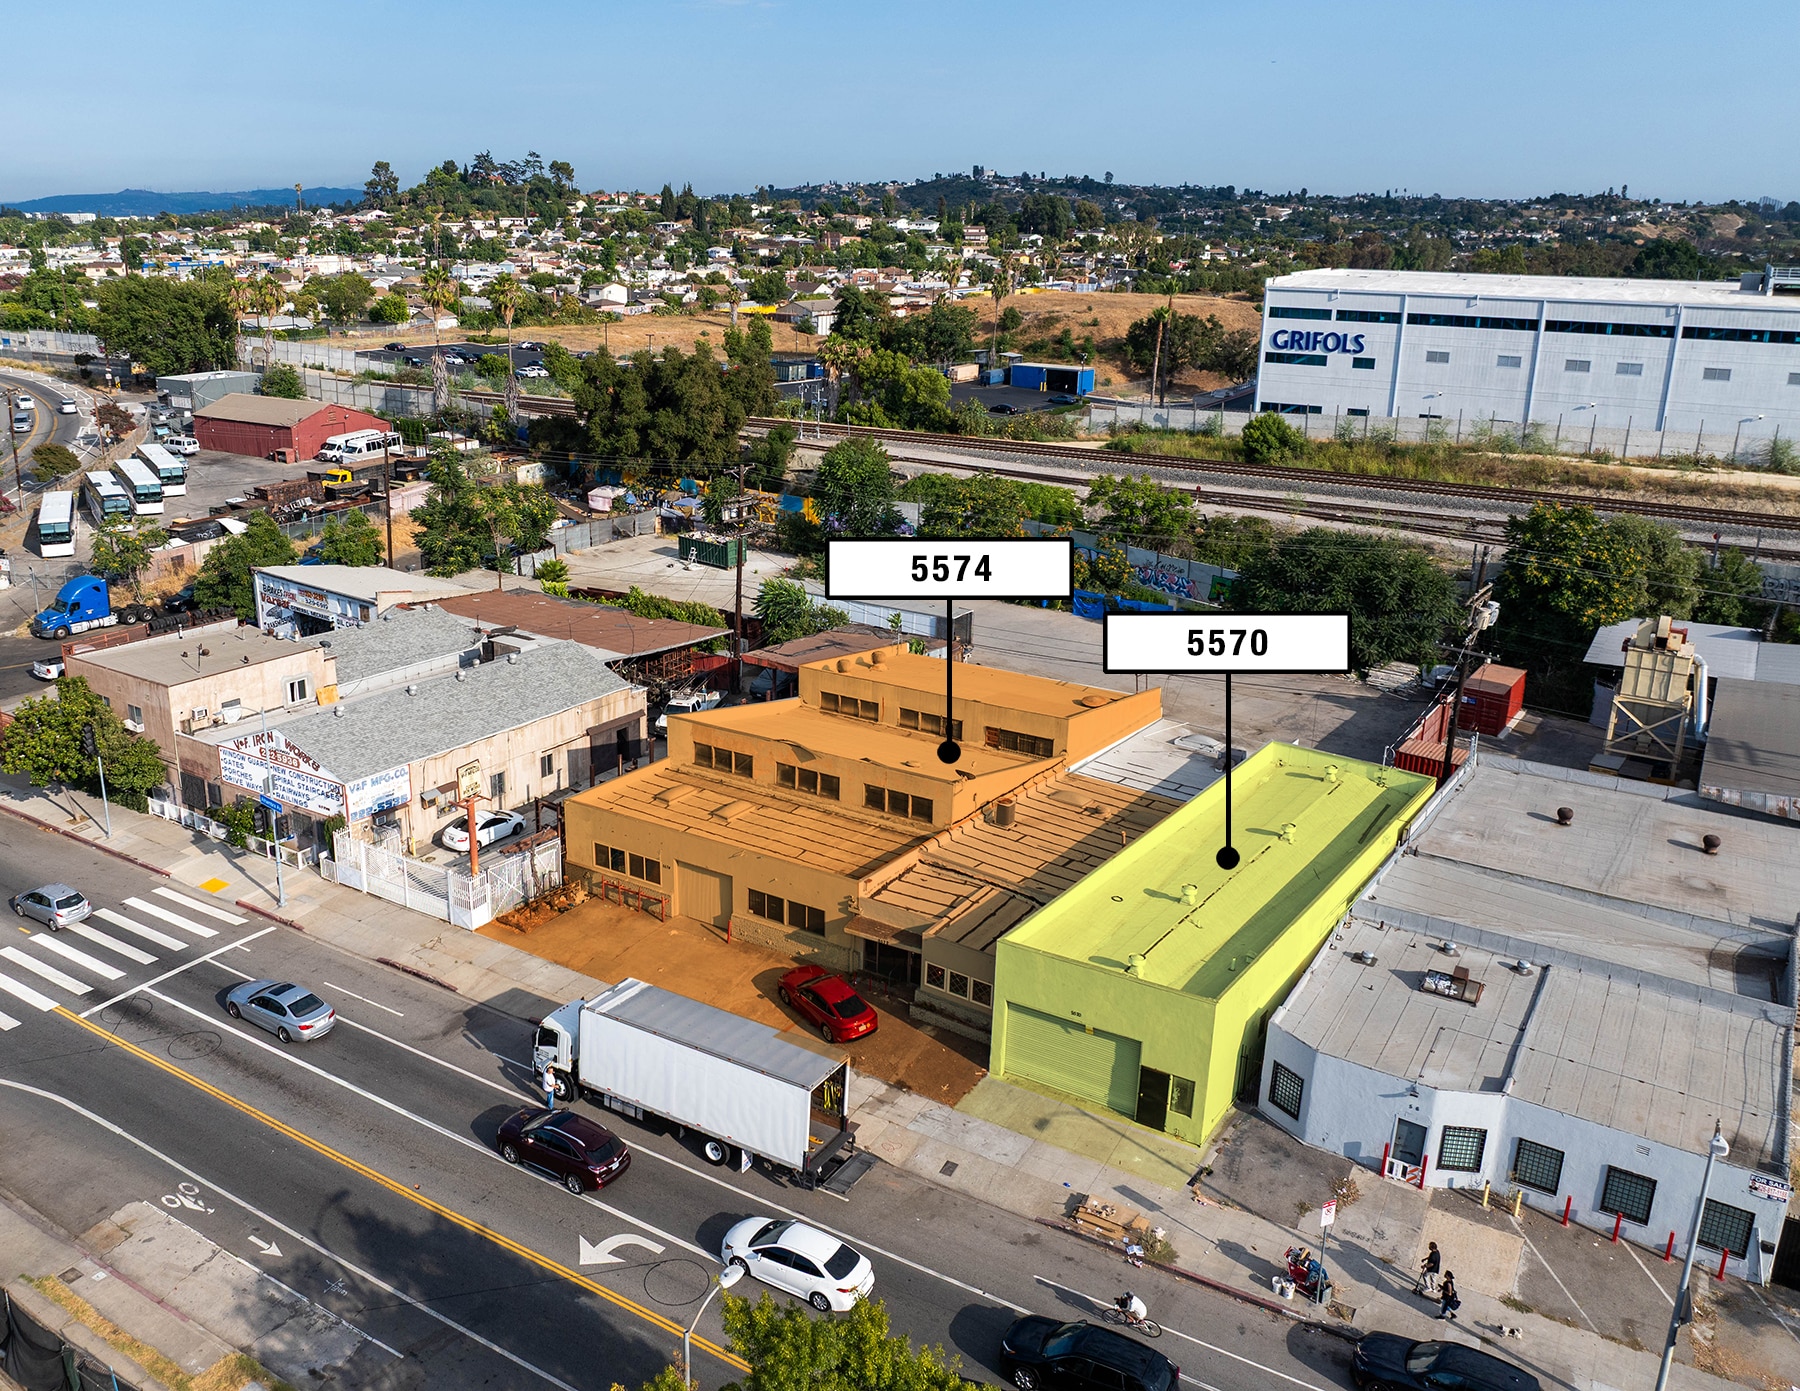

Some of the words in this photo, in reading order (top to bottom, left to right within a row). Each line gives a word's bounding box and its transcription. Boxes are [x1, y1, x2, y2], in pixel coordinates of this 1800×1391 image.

[1271, 329, 1365, 354] GRIFOLS
[222, 750, 246, 762] WINDOW
[284, 738, 321, 772] WORKS
[223, 758, 244, 770] GATES
[224, 766, 253, 781] PORCHES
[272, 765, 286, 775] NEW
[288, 770, 341, 793] CONSTRUCTION
[273, 774, 294, 786] SPIRAL
[224, 774, 244, 786] DRIVE
[246, 780, 264, 792] WAYS
[348, 780, 368, 794] V&F
[274, 783, 311, 801] STAIRWAYS
[276, 792, 309, 808] RAILINGS
[1751, 1176, 1767, 1185] FOR
[1769, 1181, 1788, 1191] SALE
